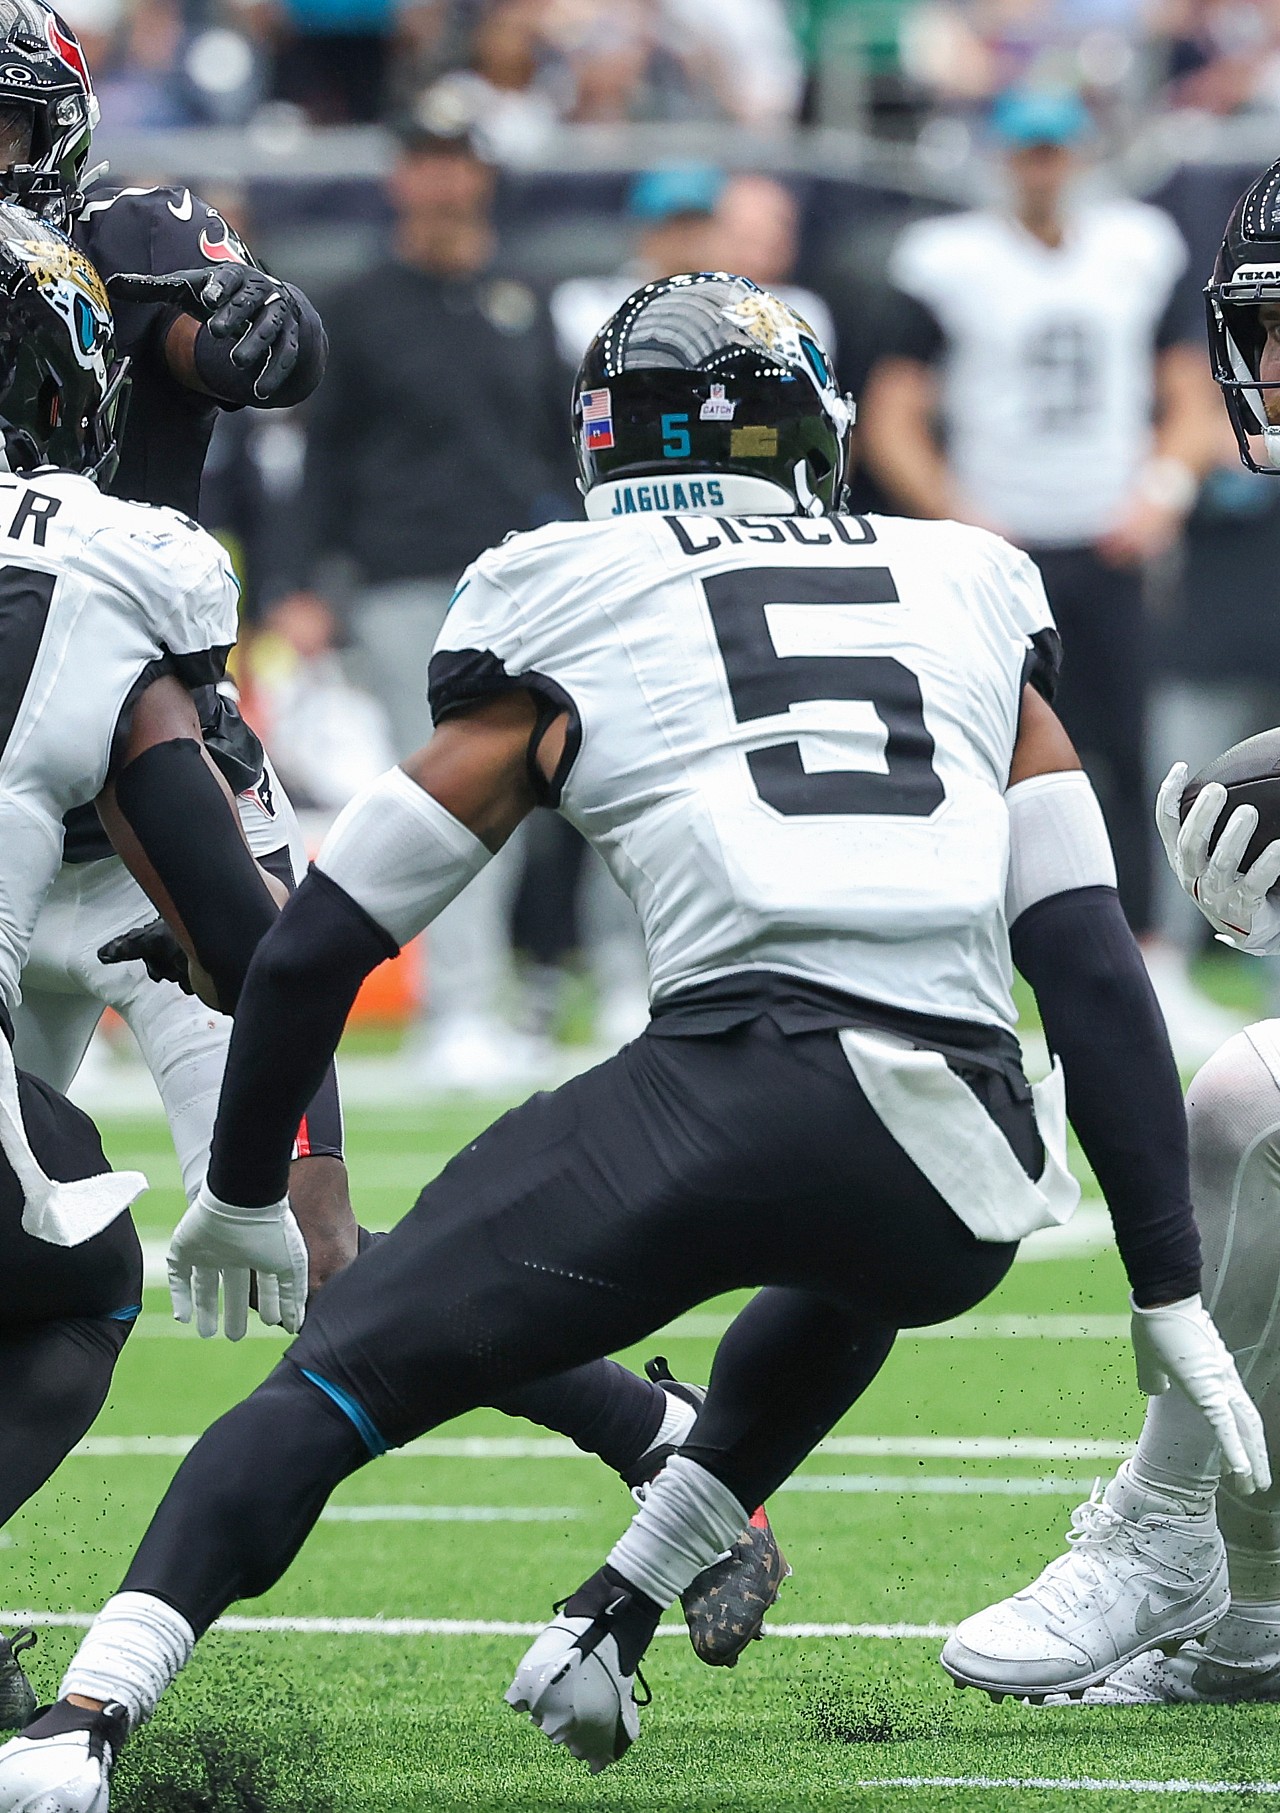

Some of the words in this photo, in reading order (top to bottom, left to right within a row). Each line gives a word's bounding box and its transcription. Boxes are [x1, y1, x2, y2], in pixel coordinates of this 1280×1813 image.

[703, 404, 731, 414] CATCH
[661, 413, 691, 457] 5
[0, 484, 62, 547] R
[612, 480, 724, 514] JAGUARS
[663, 515, 877, 555] CISCO
[701, 566, 946, 817] 5
